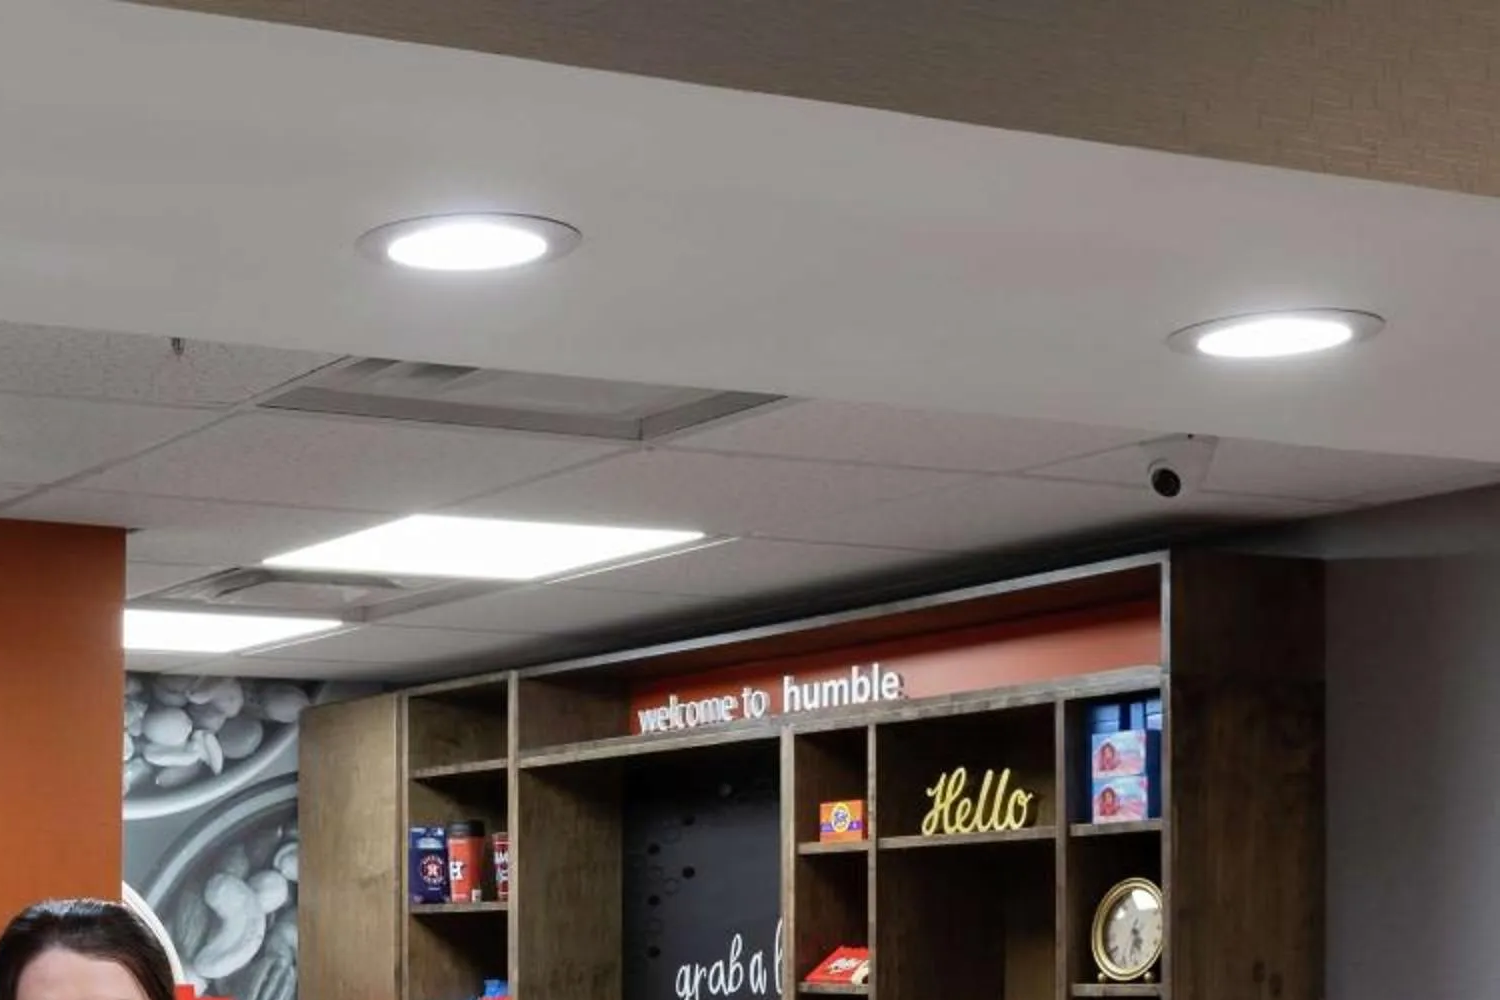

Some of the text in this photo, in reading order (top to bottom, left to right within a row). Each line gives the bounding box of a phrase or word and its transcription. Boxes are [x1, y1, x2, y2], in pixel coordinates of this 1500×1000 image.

[637, 662, 902, 734] welcome to humble
[921, 766, 1034, 836] Hello
[750, 950, 767, 995] a
